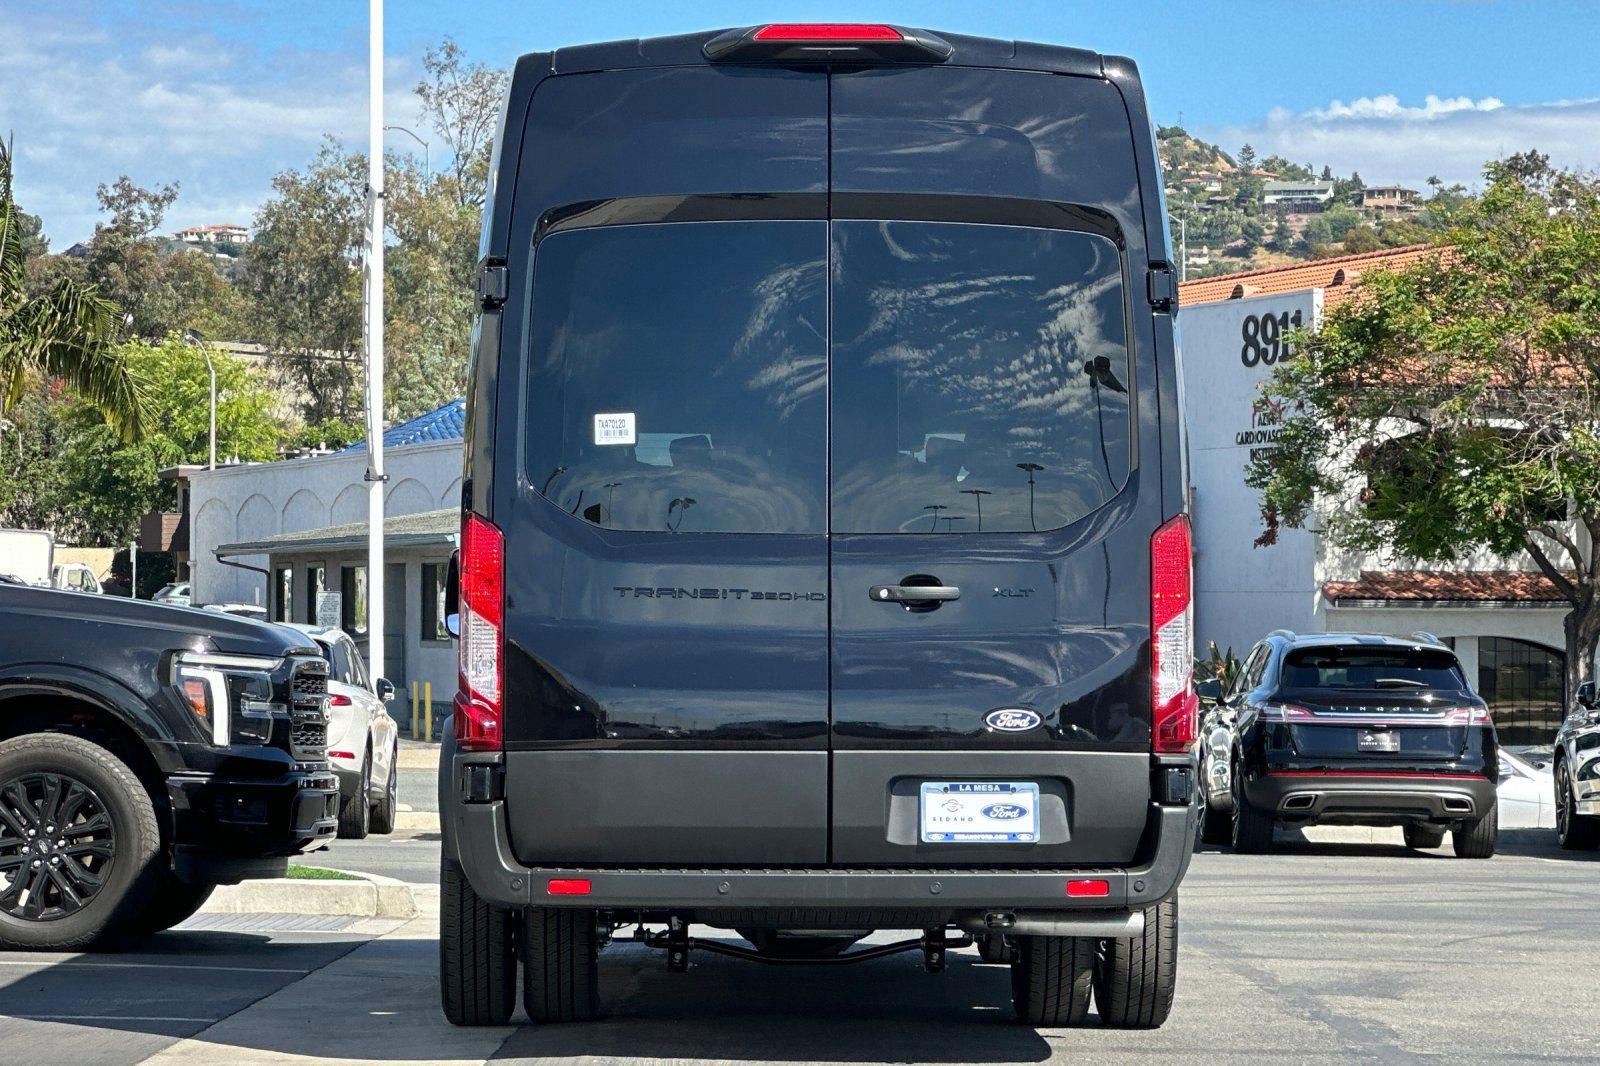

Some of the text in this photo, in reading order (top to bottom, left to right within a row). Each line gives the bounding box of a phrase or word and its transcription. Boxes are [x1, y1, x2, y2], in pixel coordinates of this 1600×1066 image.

[1235, 429, 1284, 445] CARDIOVASC
[613, 586, 749, 600] TRANSIT
[992, 588, 1036, 598] XLT
[959, 784, 1001, 792] LA MESA
